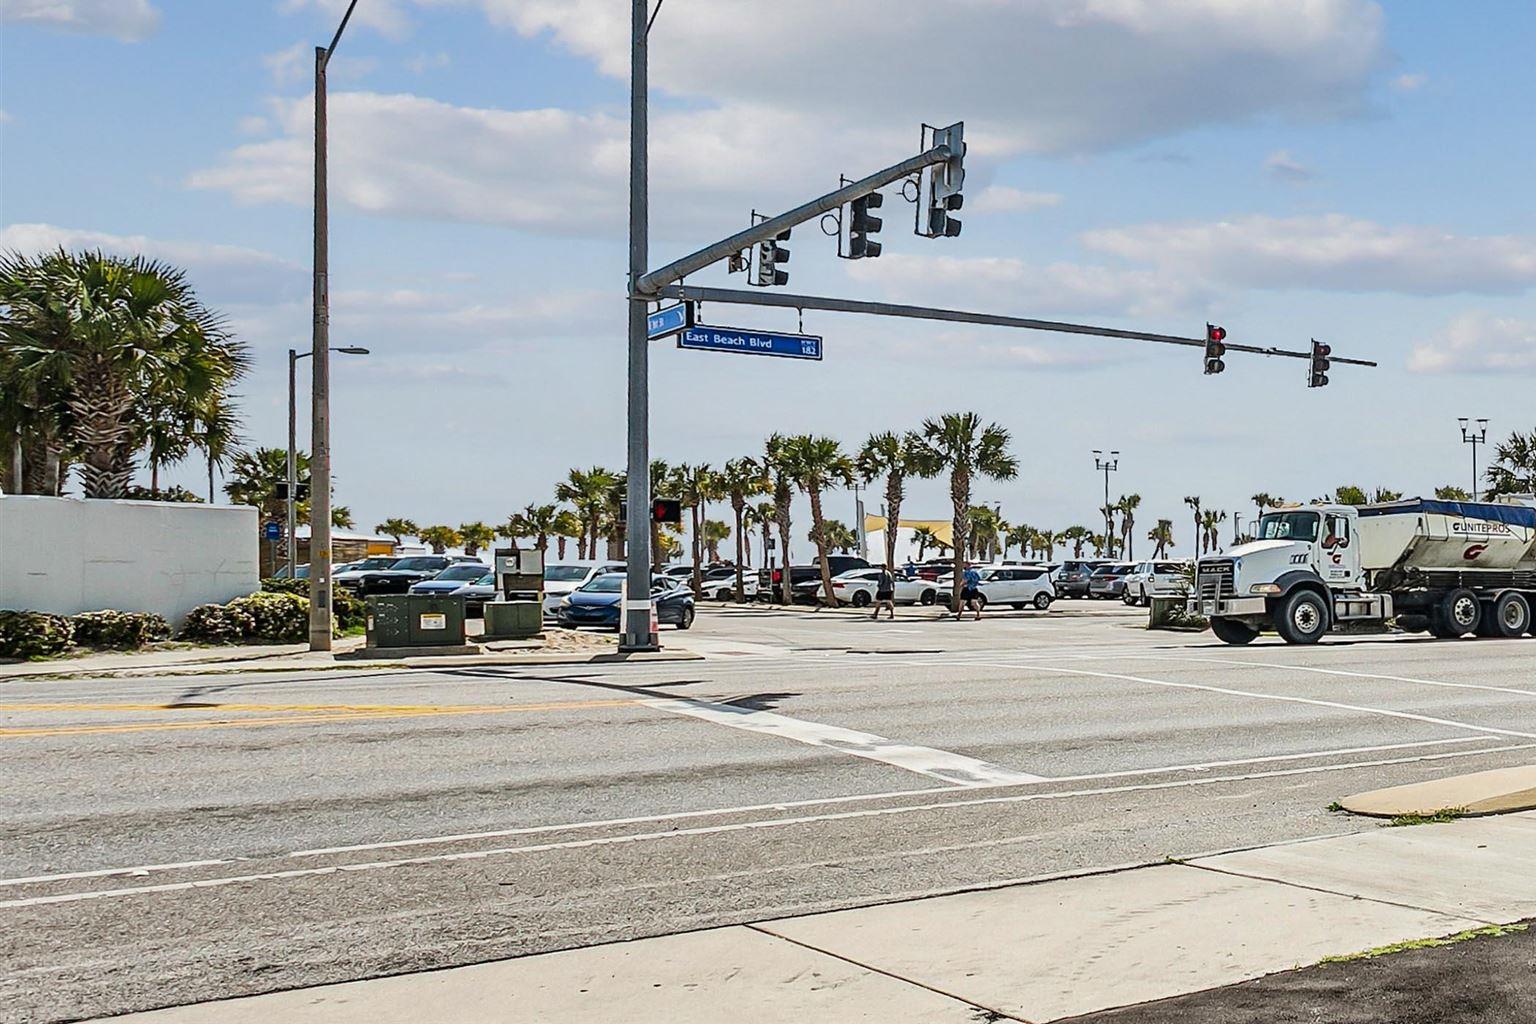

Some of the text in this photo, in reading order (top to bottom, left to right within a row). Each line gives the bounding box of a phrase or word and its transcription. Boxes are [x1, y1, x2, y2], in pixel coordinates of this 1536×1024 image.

[685, 331, 772, 349] East Beach Blvd
[801, 347, 817, 356] 182
